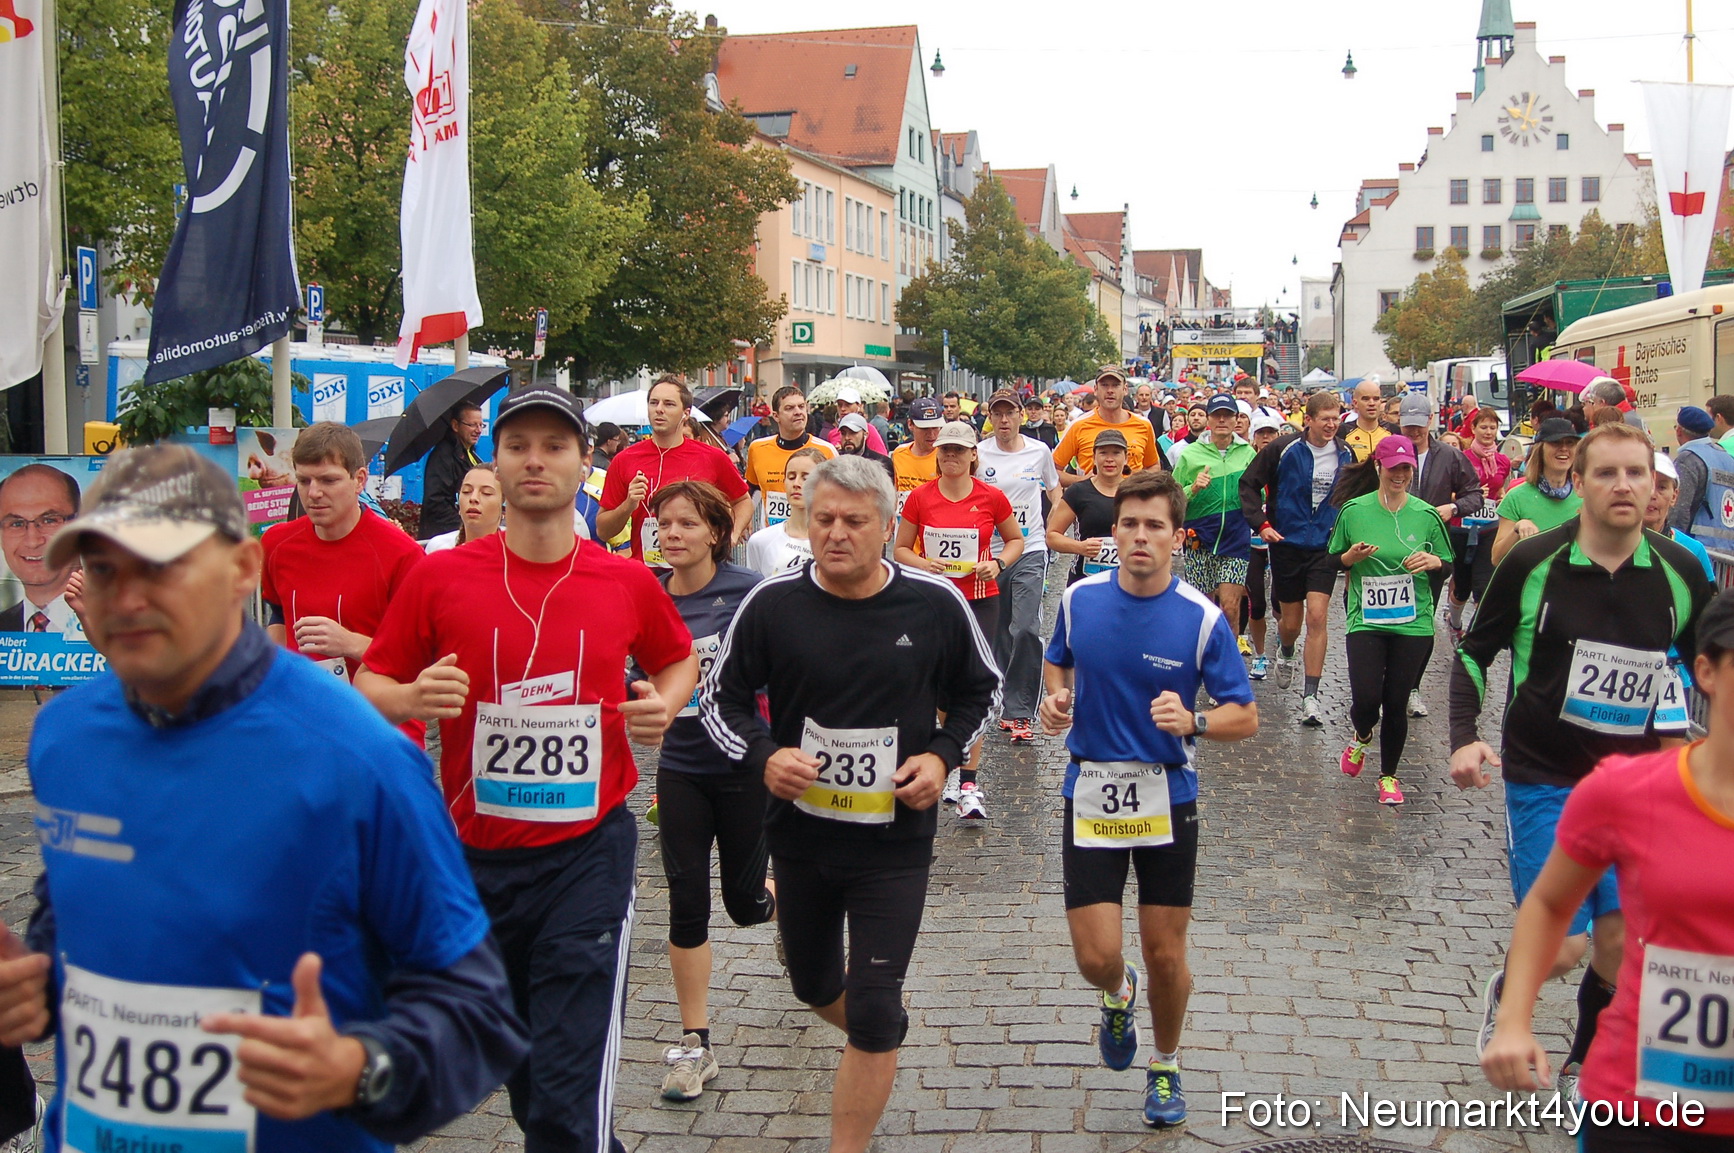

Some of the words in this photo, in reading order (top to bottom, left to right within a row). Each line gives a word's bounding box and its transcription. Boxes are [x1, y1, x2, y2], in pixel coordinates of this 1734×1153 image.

[82, 256, 93, 301] P
[311, 290, 320, 317] P
[795, 325, 811, 341] D
[1202, 347, 1232, 355] START
[1636, 336, 1686, 363] Bayerisches
[1635, 366, 1658, 385] Rotes
[1635, 390, 1657, 408] Kreuz
[247, 501, 269, 511] BEIDE
[939, 540, 962, 559] 25
[1367, 586, 1410, 606] 3074
[1576, 649, 1608, 662] PARTL
[1610, 656, 1652, 669] Neumarkt
[521, 683, 553, 698] DEHN
[1578, 664, 1653, 703] 2484
[479, 714, 518, 729] PARTL
[521, 718, 580, 729] Neumarkt
[1589, 706, 1630, 723] Florian
[805, 727, 829, 747] PARTL
[831, 738, 879, 748] Neumarkt
[486, 733, 589, 776] 2283
[816, 750, 876, 787] 233
[1106, 769, 1150, 779] Neumarkt
[507, 786, 566, 804] Florian
[831, 793, 853, 808] Adi
[1101, 782, 1140, 814] 34
[1093, 820, 1151, 836] Christoph
[1648, 961, 1703, 983] PARTL
[67, 987, 108, 1017] PARTL
[113, 1003, 201, 1028] Neumark
[1658, 987, 1734, 1049] 20
[75, 1023, 232, 1115] 2482
[95, 1125, 184, 1153] Marius
